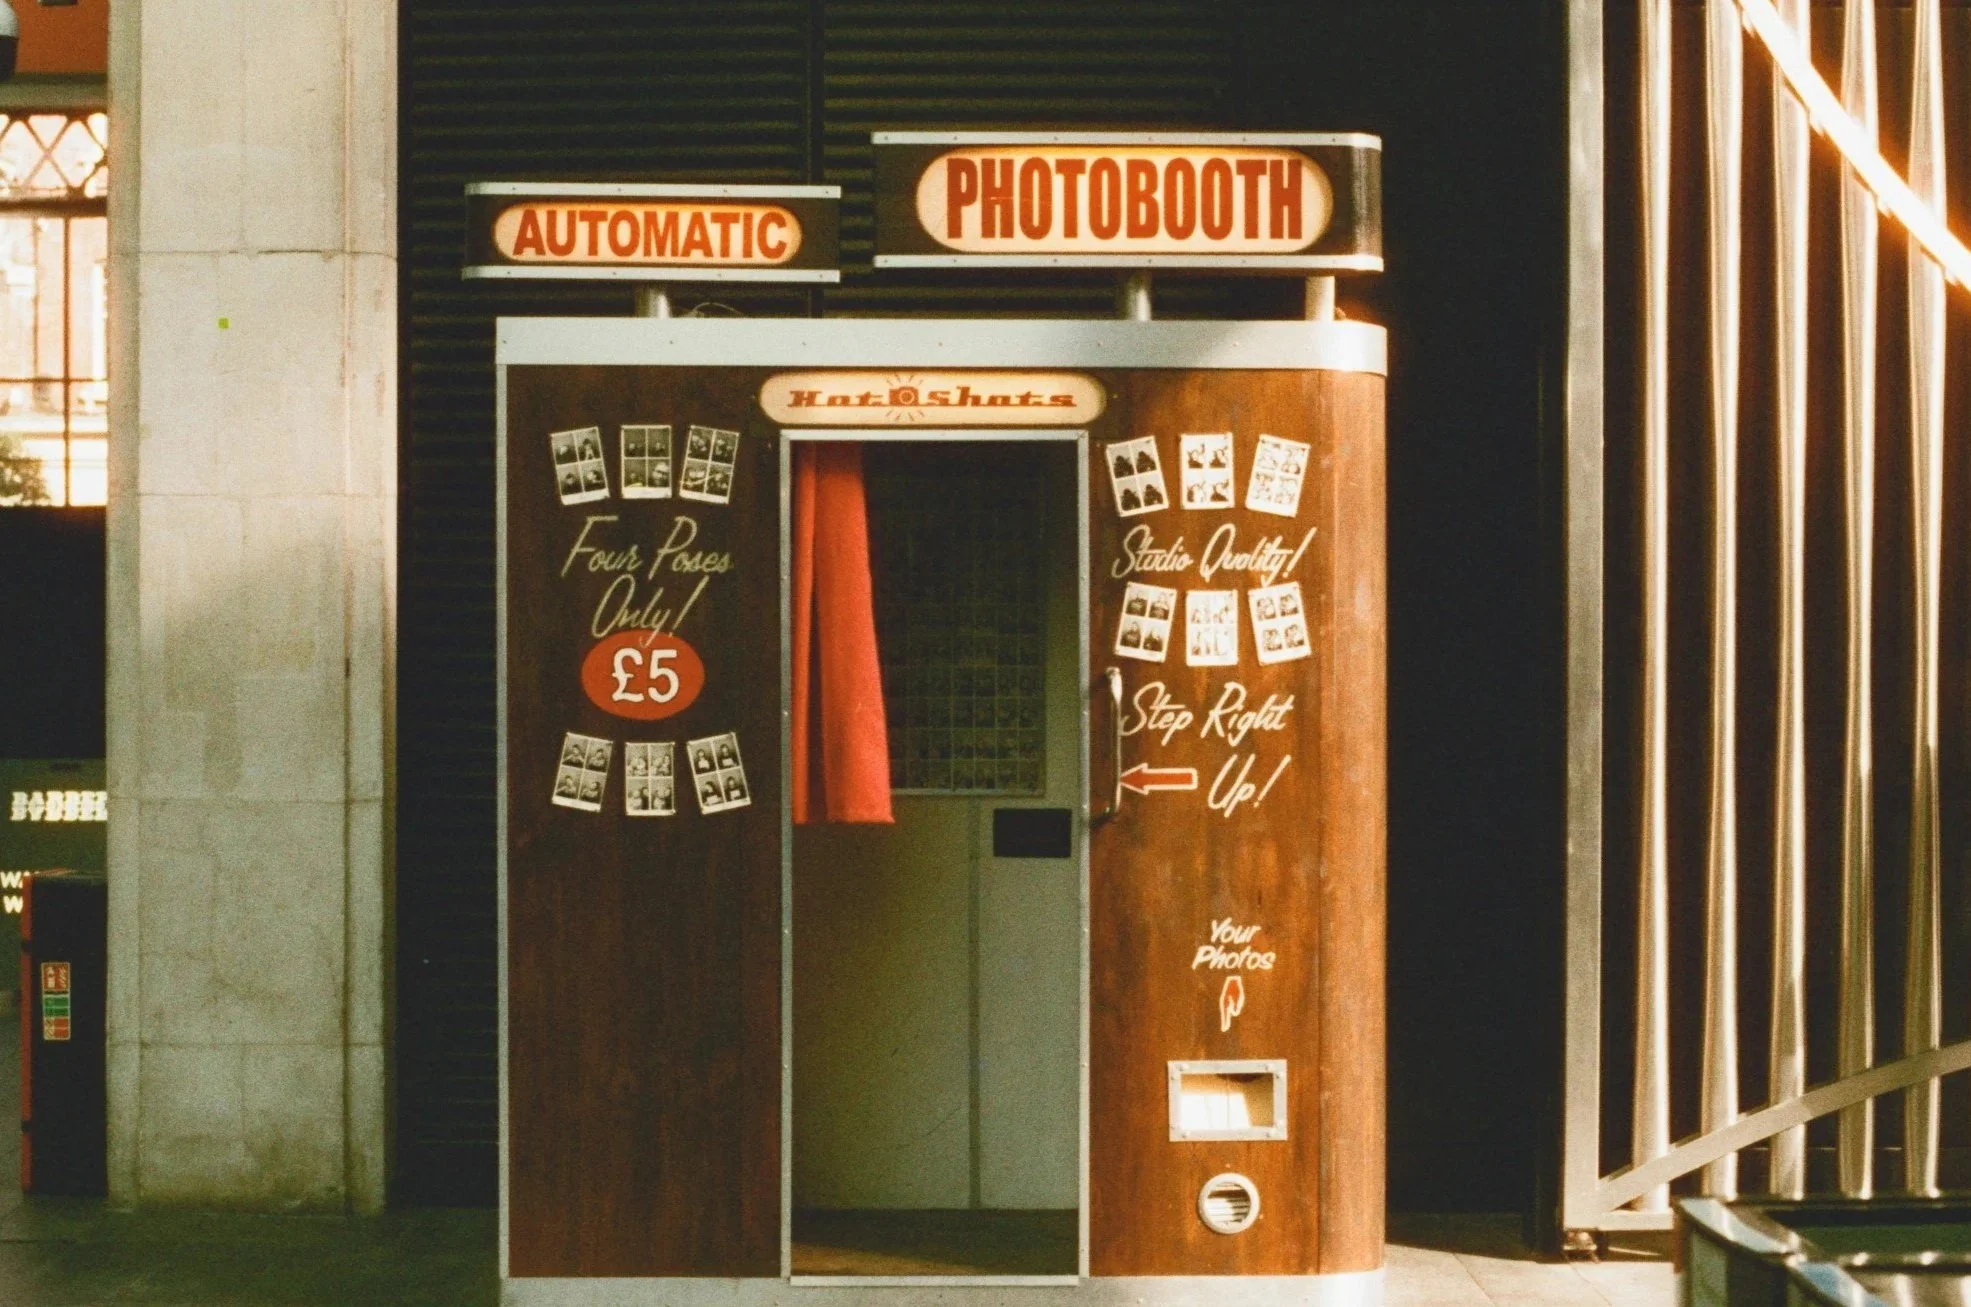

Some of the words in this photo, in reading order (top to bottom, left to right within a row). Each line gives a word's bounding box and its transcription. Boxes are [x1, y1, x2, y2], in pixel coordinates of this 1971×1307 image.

[945, 155, 1303, 242] PHOTOBOOTH
[512, 207, 790, 260] AUTOMATIC
[787, 390, 883, 408] Hot
[926, 385, 1077, 408] Shots
[560, 514, 643, 578] Four
[647, 514, 731, 581] Poses
[1112, 523, 1193, 579] Studio
[1199, 522, 1318, 589] Quality!
[590, 574, 710, 648] Only!
[610, 647, 681, 704] £5
[1121, 681, 1194, 748] Step
[1200, 680, 1295, 748] Right
[1207, 754, 1292, 819] Up!
[1192, 944, 1277, 971] Photos
[1209, 917, 1262, 945] Your
